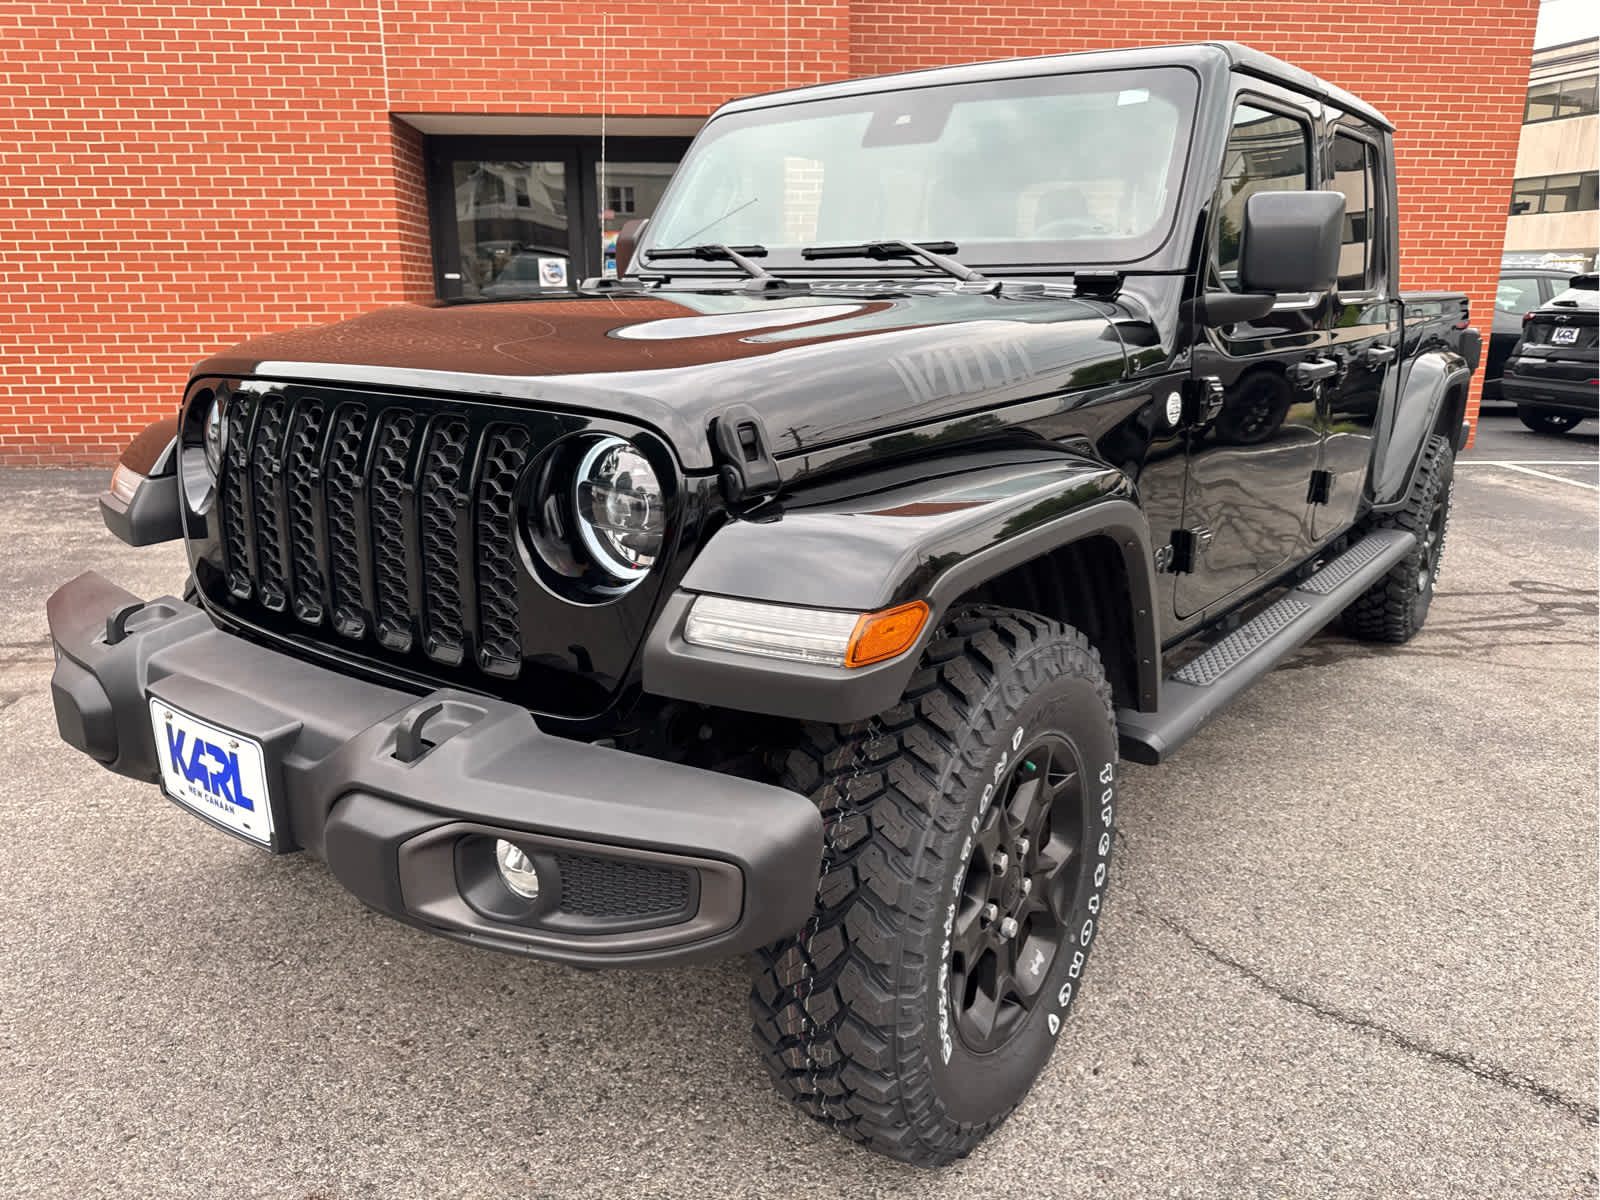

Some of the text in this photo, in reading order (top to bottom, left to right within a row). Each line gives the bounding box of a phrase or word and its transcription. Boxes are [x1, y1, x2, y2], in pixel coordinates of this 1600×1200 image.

[166, 722, 255, 812] KARL
[188, 785, 235, 814] NEW CANAAN
